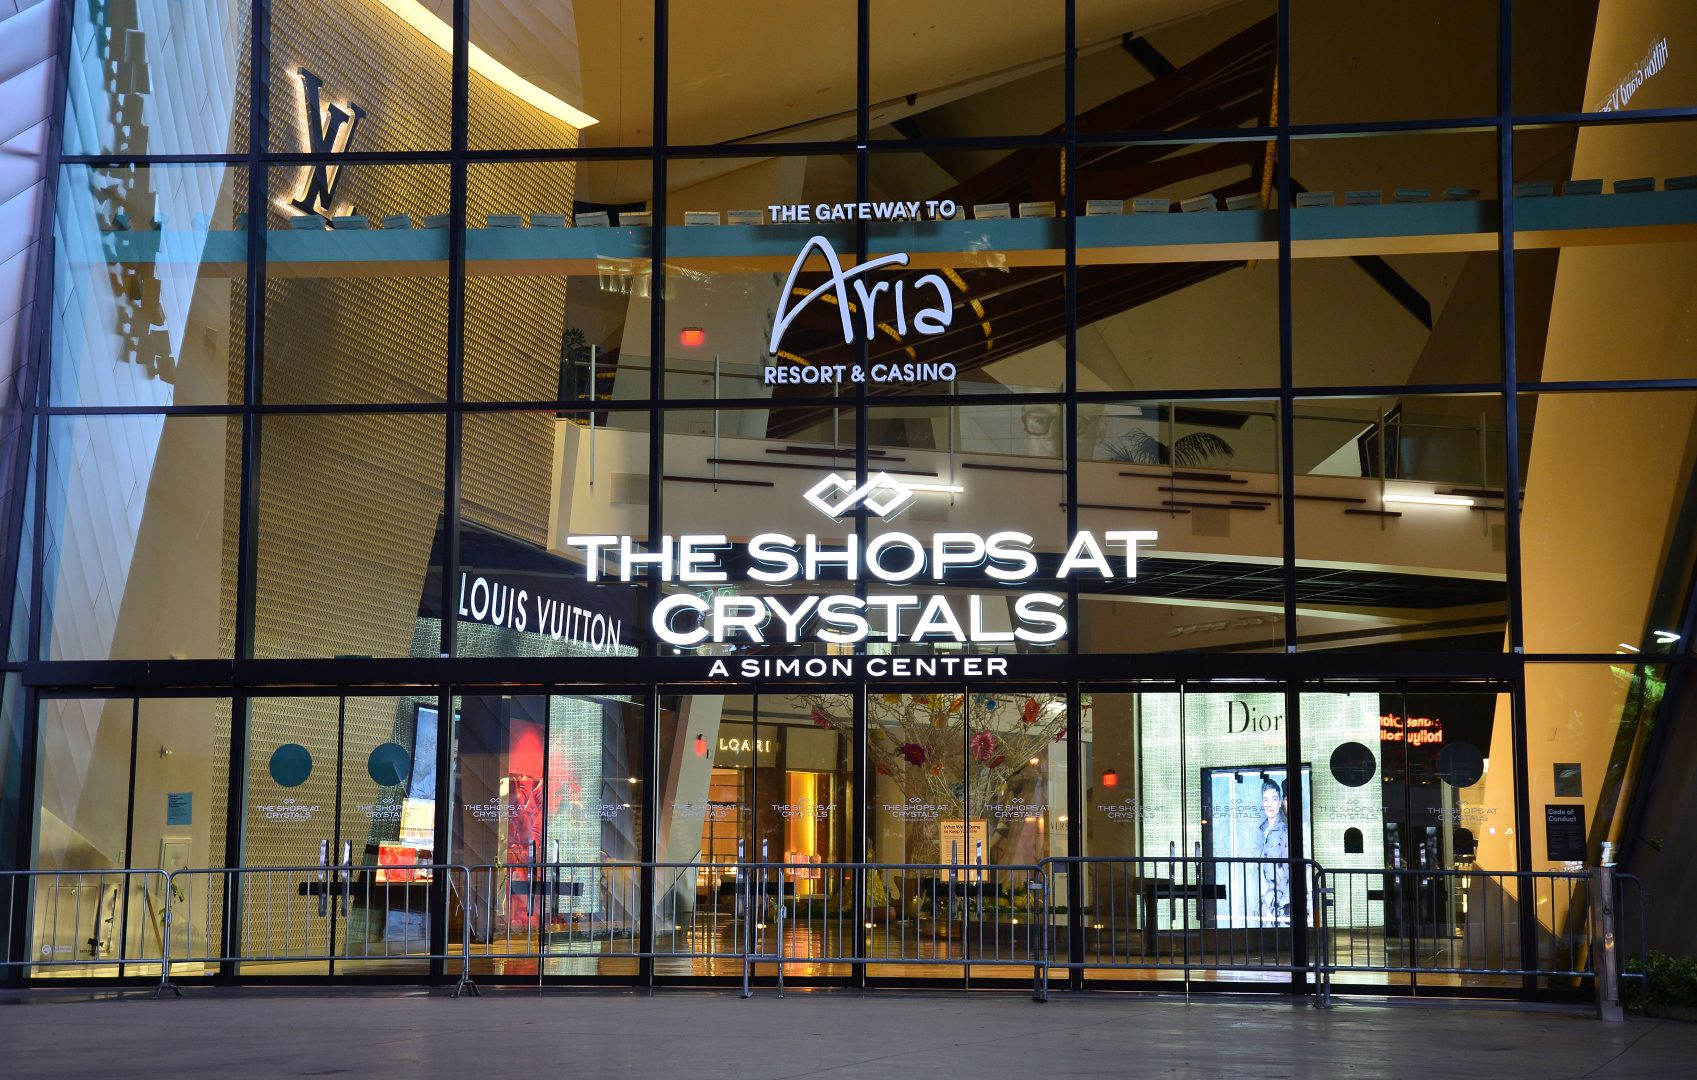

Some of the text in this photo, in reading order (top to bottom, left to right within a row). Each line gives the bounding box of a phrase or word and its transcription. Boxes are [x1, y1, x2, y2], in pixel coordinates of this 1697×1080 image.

[768, 200, 956, 222] THE GATEWAY TO
[769, 235, 953, 356] Aria
[765, 363, 956, 384] RESORT & CASINO
[567, 530, 1158, 582] THE SHOPS AT
[459, 572, 621, 655] LOUIS VUITTON
[652, 592, 1068, 645] CRYSTALS
[708, 658, 1008, 677] A SIMON CENTER
[1225, 701, 1282, 733] Dior
